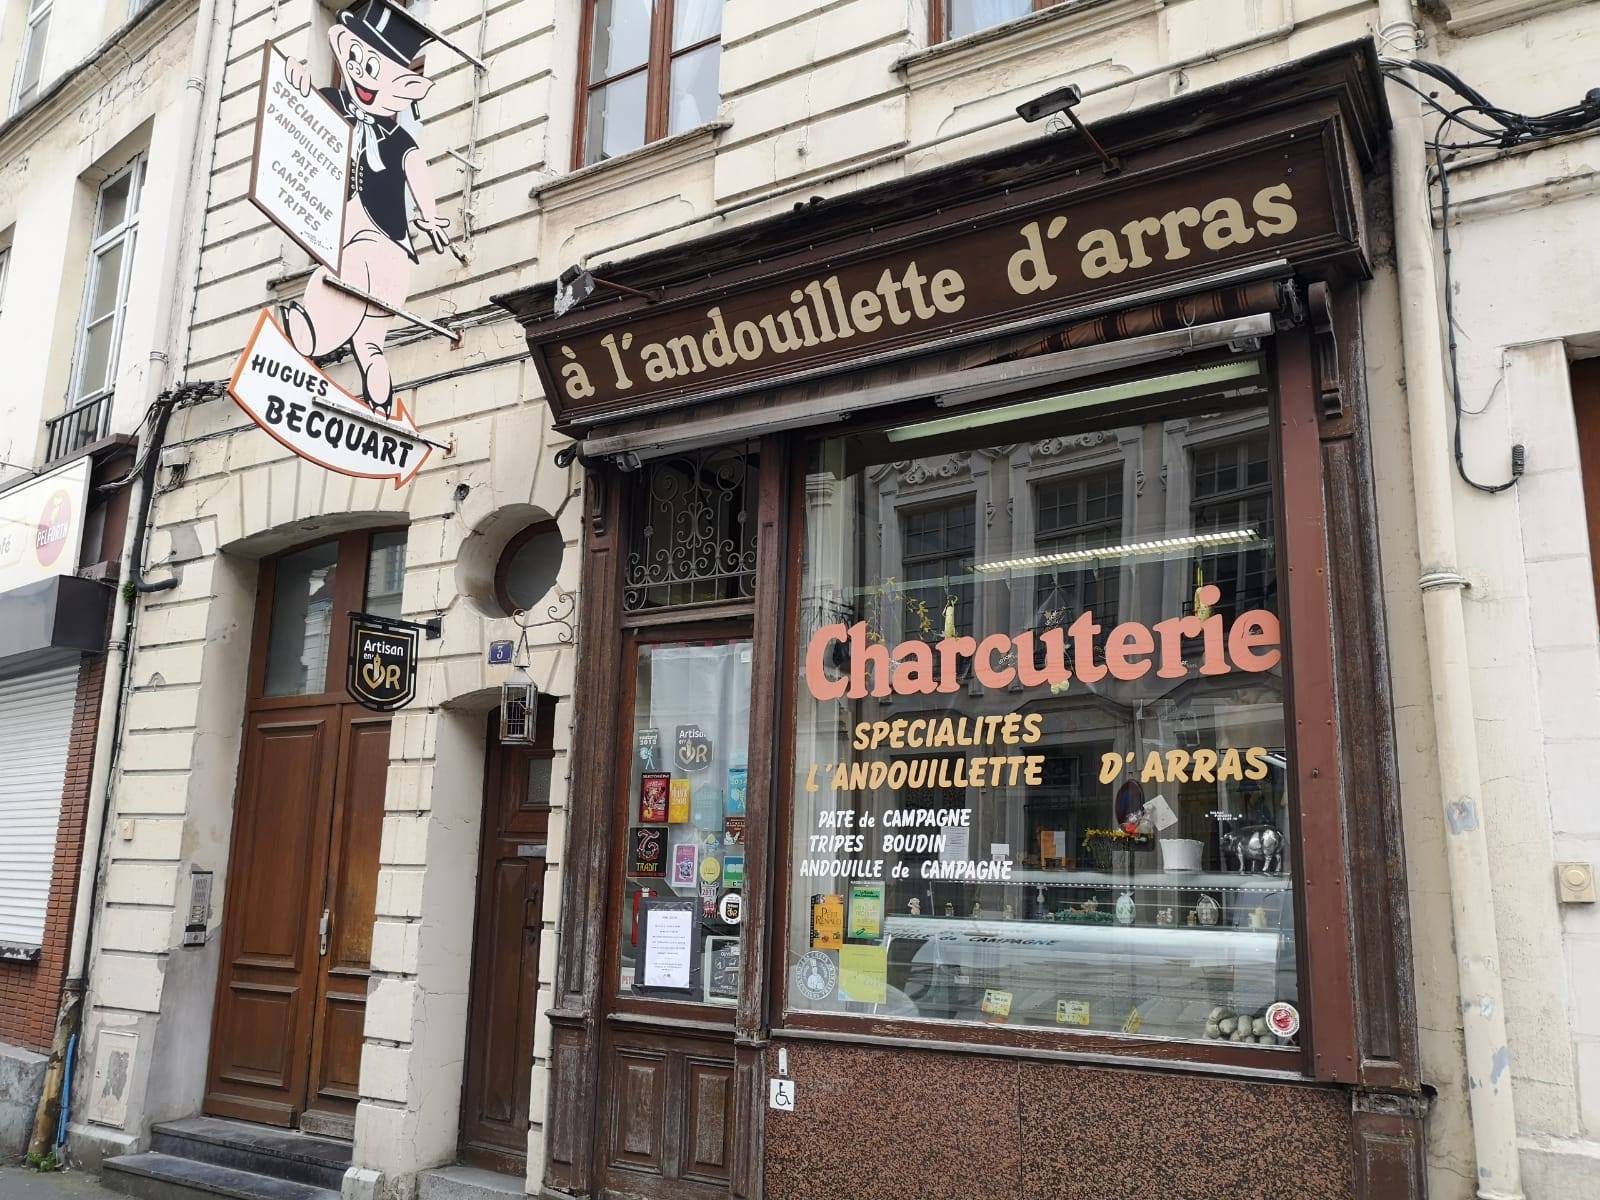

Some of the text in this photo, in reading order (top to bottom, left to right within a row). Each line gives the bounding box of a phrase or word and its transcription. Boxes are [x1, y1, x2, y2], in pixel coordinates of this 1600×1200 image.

[266, 104, 343, 181] D'ANDOUILLETTES
[271, 160, 334, 221] CAMPAGNE
[277, 187, 321, 231] TRIPES
[561, 183, 1298, 399] à l'andouillette d'arras
[251, 354, 329, 397] HUGUES
[265, 395, 414, 468] BECQUART
[363, 639, 404, 657] Artisan
[805, 585, 1281, 701] Charcuterie
[805, 747, 1269, 791] L'ANDOUILLETTE D'ARRAS
[859, 811, 875, 828] de
[882, 808, 972, 827] CAMPAGNE
[809, 835, 865, 853] TRIPES
[882, 834, 947, 853] BOUDIN
[800, 859, 1013, 880] ANDOUILLE de CAMPAGNE
